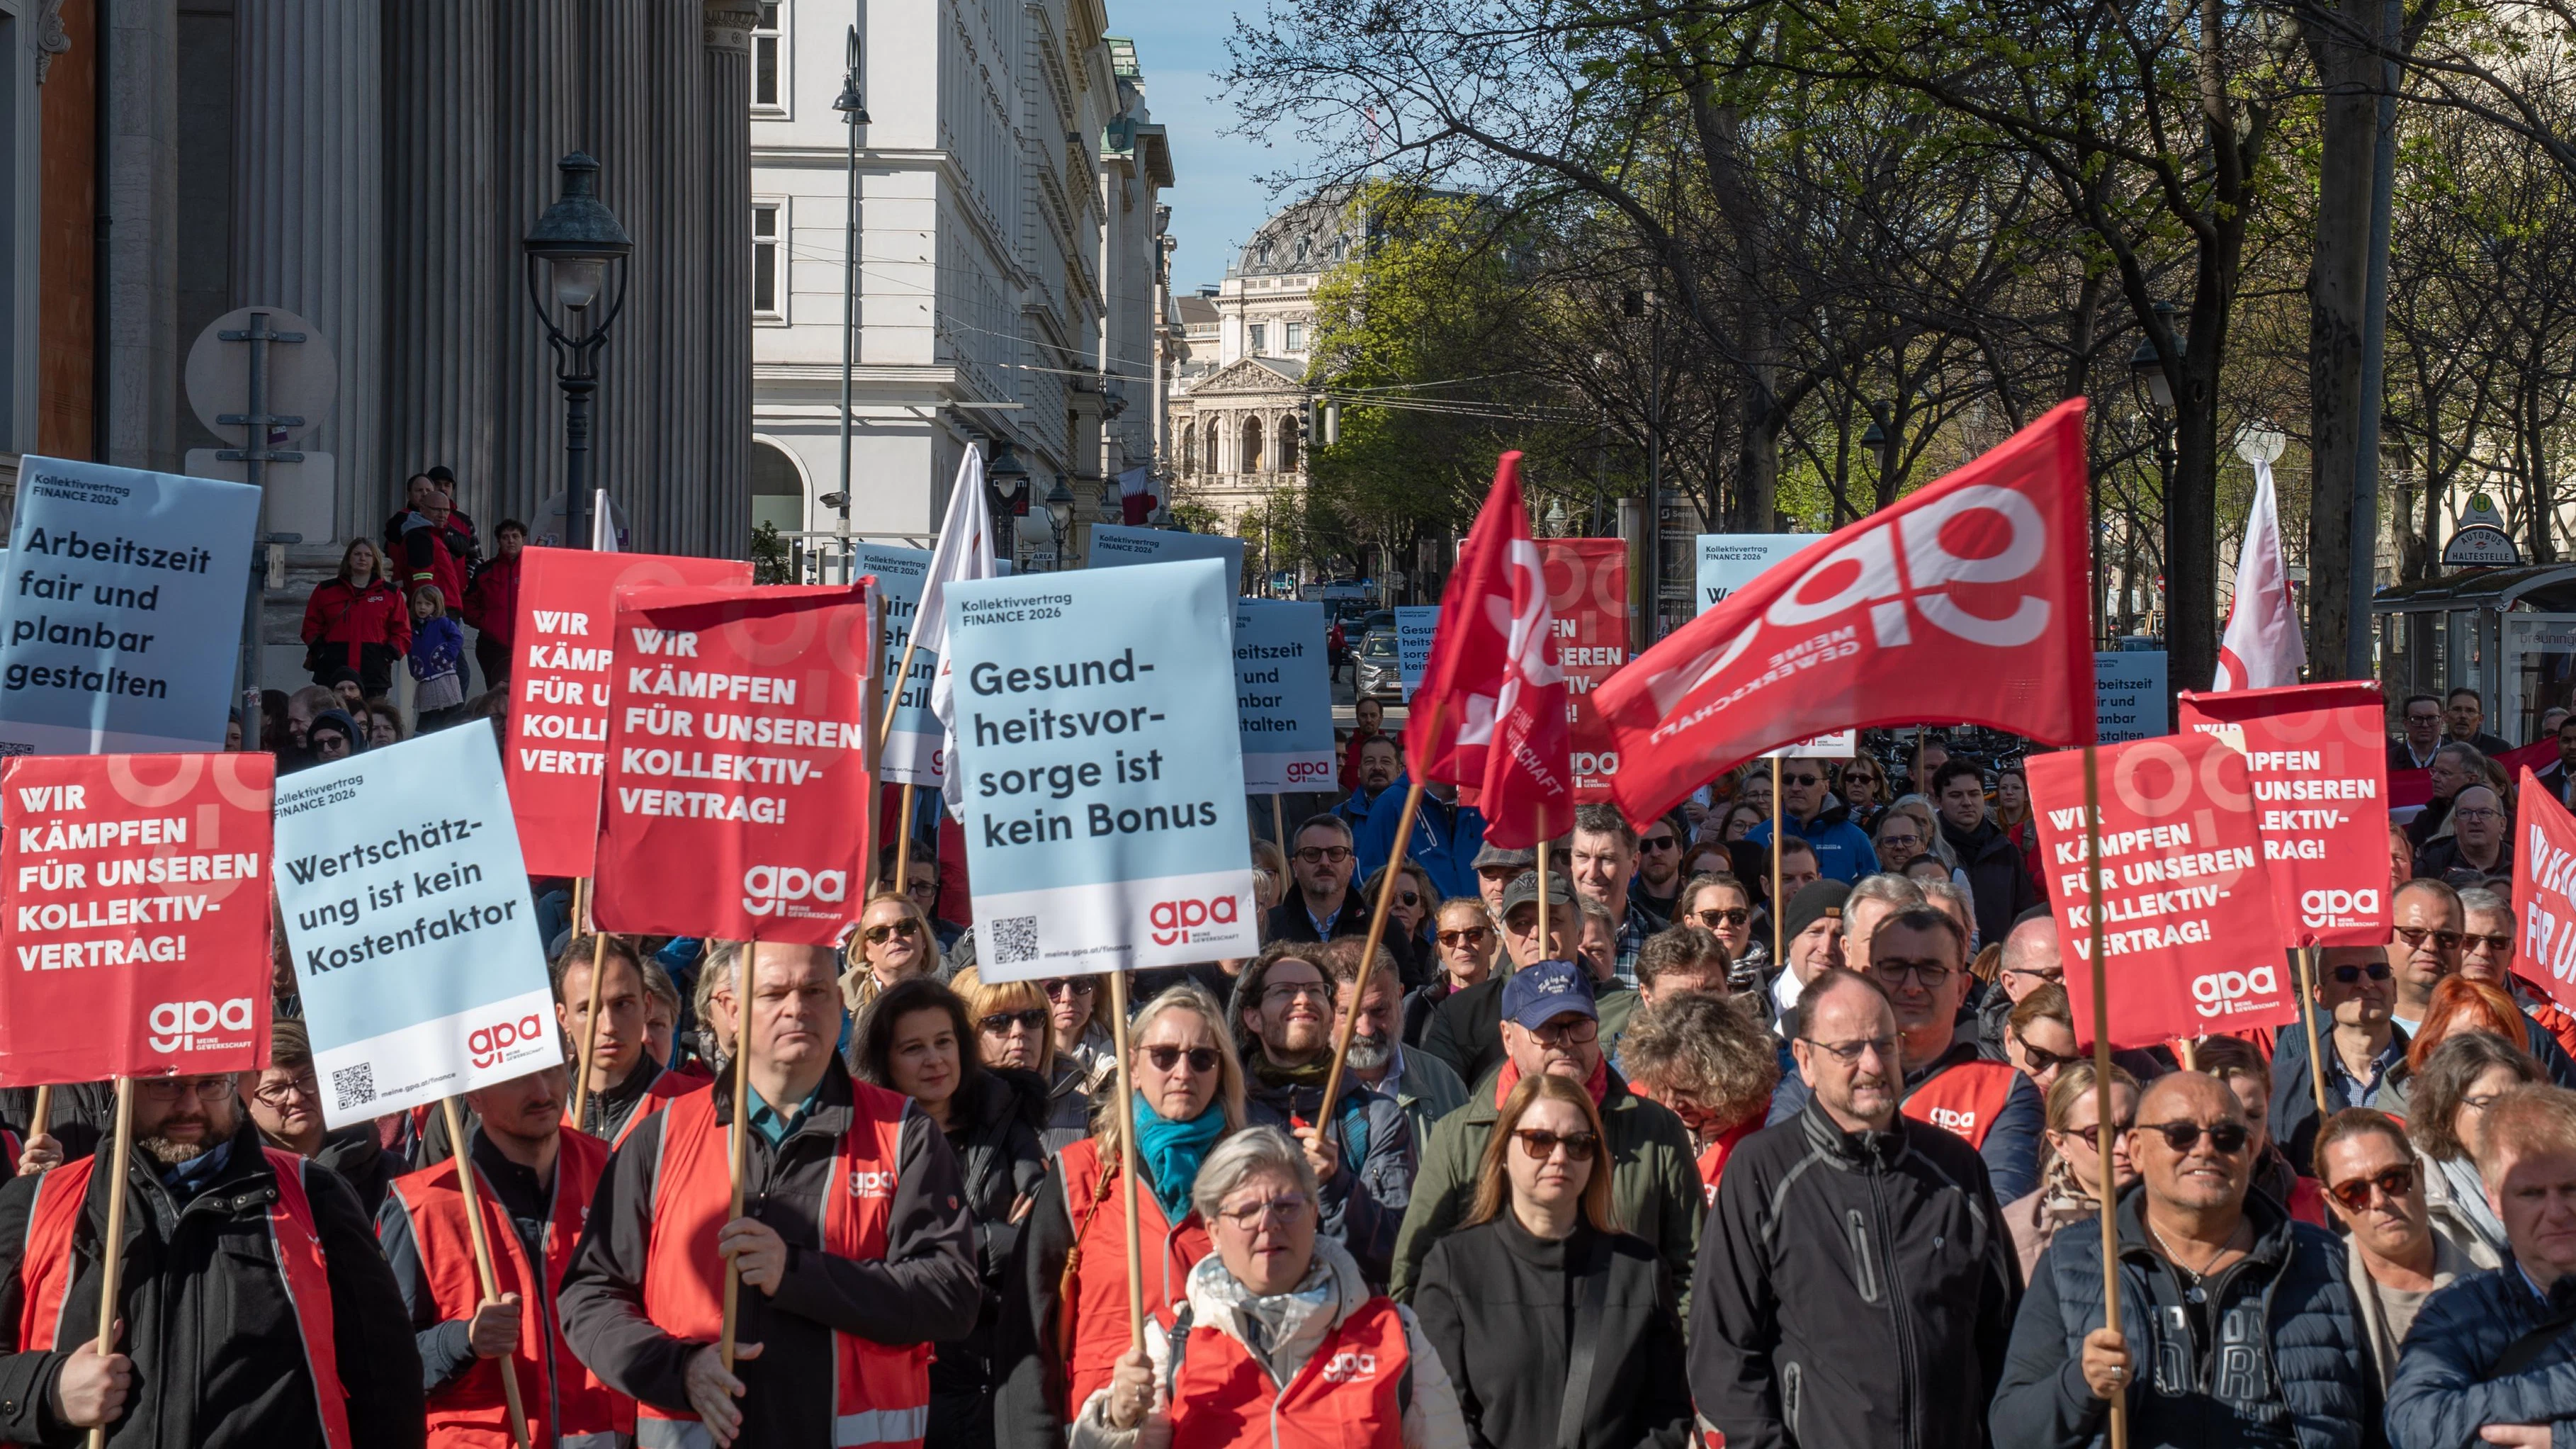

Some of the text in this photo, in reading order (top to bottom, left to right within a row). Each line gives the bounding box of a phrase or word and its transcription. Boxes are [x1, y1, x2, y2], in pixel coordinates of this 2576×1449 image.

[33, 486, 118, 505] FINANCE 2026
[35, 474, 130, 497] Kollektivvertrag
[24, 527, 212, 574] Arbeitszeit
[1099, 534, 1160, 548] Kollektivvertrag
[1099, 542, 1133, 551] FINANCE
[2452, 552, 2509, 560] HALTESTELLE
[2461, 531, 2503, 546] AUTOBUS
[863, 563, 919, 575] FINANCE 2026
[864, 554, 926, 569] Kollektivvertrag
[20, 570, 159, 611] fair und
[961, 593, 1073, 612] Kollektivvertrag
[11, 615, 154, 653] planbar
[533, 610, 589, 636] WIR
[963, 607, 1062, 626] FINANCE 2026
[631, 628, 699, 658] WIR
[5, 663, 166, 699] gestalten
[526, 675, 584, 705] FÜR
[628, 663, 796, 705] KÄMPFEN
[970, 648, 1154, 696] Gesund-
[1244, 667, 1279, 684] und
[2110, 695, 2135, 707] und
[625, 703, 862, 750] FÜR UNSEREN
[974, 706, 1165, 747] heitsvor-
[621, 747, 823, 786] KOLLEKTIV-
[979, 749, 1163, 799] sorge ist
[1287, 761, 1329, 783] gpa
[18, 784, 86, 813] WIR
[274, 774, 363, 806] ollektivvertrag
[328, 788, 356, 804] 2026
[618, 787, 786, 824] VERTRAG!
[2254, 779, 2376, 801] UNSEREN
[19, 817, 187, 853] KÄMPFEN
[983, 800, 1217, 847] kein Bonus
[2259, 809, 2349, 830] EKTIV-
[285, 818, 482, 886] Wertschätz-
[2123, 846, 2256, 886] UNSEREN
[18, 852, 259, 892] FÜR UNSEREN
[299, 862, 482, 931] ung ist kein
[742, 864, 847, 917] gpa
[2301, 889, 2380, 928] gpa
[18, 895, 221, 932] KOLLEKTIV-
[1150, 895, 1238, 946] gpa
[17, 935, 186, 971] VERTRAG!
[306, 898, 517, 976] Kostenfaktor
[2192, 966, 2278, 1017] gpa
[149, 998, 253, 1054] gpa
[468, 1014, 542, 1069] gpa
[196, 1041, 252, 1051] GEWERKSCHAFT
[380, 1072, 456, 1098] meine.gpa.at/finance
[849, 1171, 894, 1198] gpa
